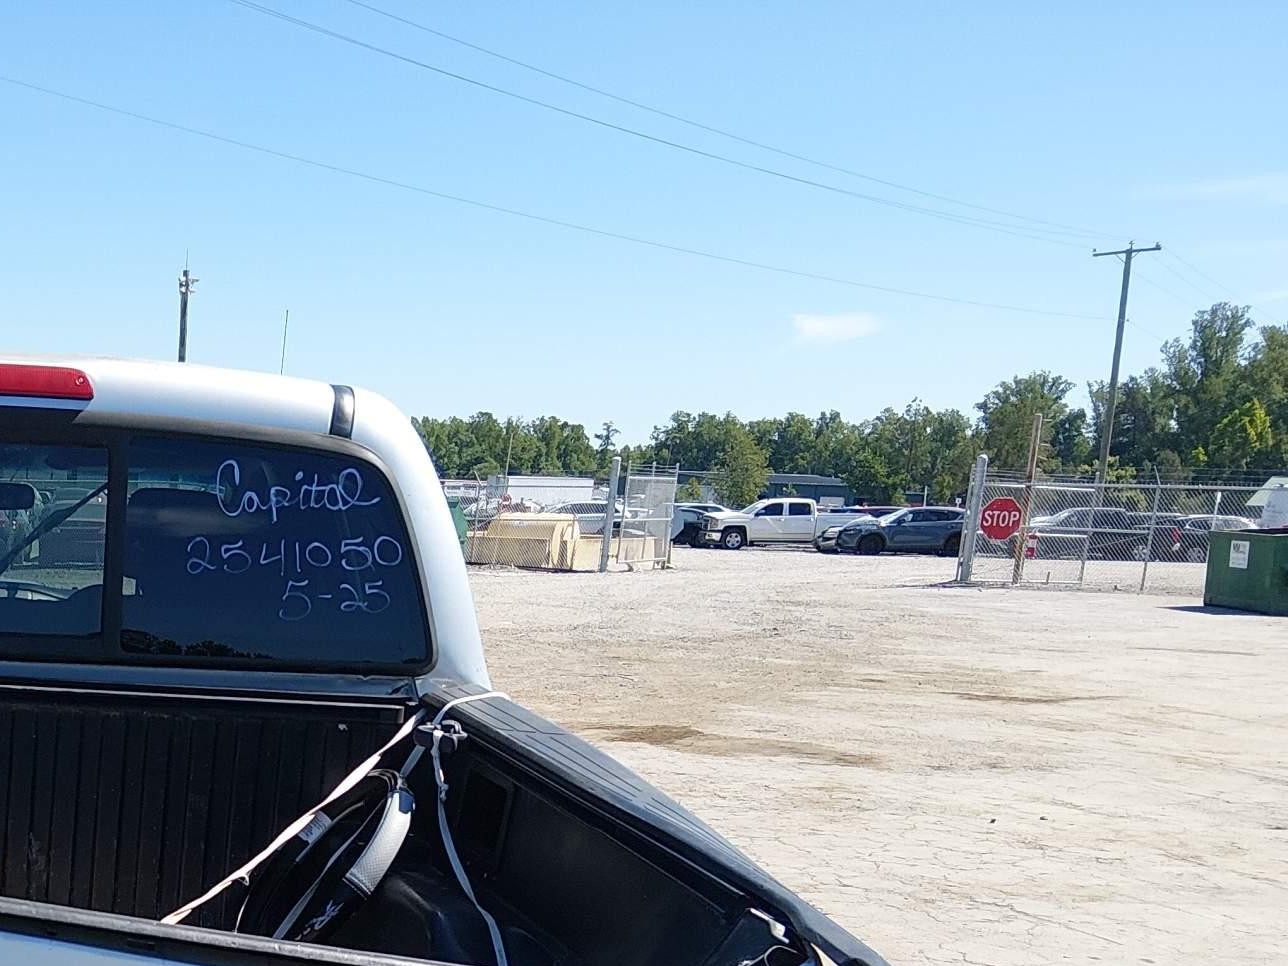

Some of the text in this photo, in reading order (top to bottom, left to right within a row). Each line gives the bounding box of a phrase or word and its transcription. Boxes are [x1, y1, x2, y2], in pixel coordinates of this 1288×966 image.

[216, 459, 381, 524] Capital
[982, 510, 1020, 527] STOP
[278, 579, 391, 621] 5-25
